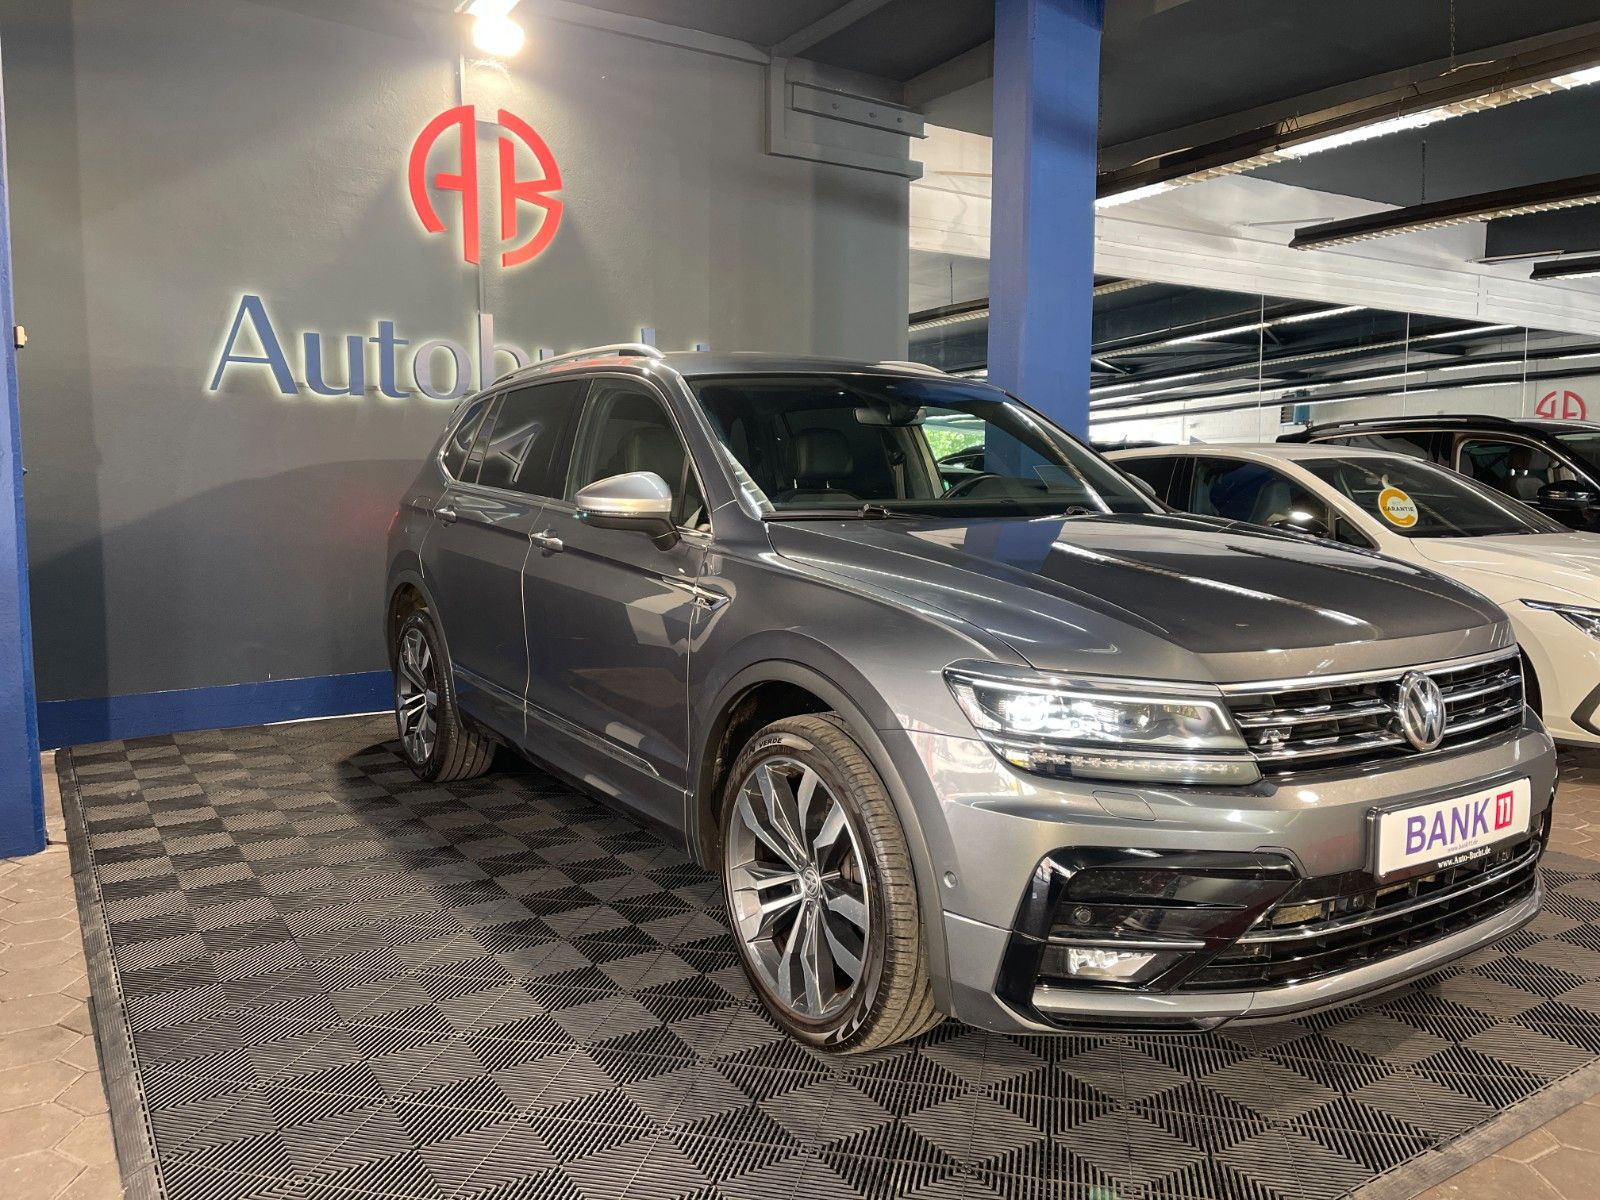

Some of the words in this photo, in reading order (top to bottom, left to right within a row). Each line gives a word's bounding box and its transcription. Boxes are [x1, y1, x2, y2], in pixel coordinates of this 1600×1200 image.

[408, 104, 564, 267] AB
[209, 294, 710, 399] Autob
[760, 737, 783, 747] VERDE
[1405, 797, 1491, 855] BANK
[1496, 791, 1513, 829] 11
